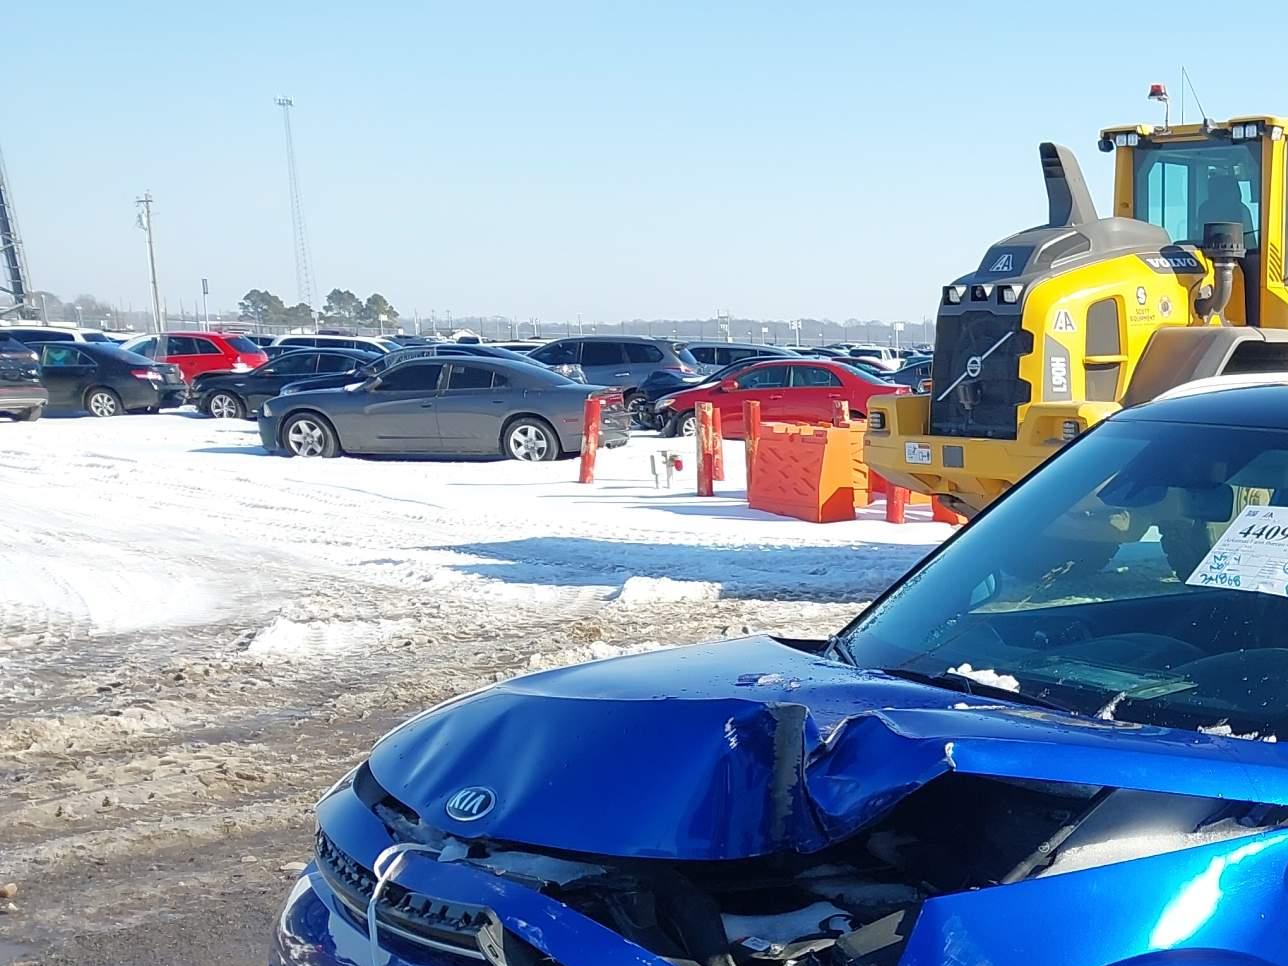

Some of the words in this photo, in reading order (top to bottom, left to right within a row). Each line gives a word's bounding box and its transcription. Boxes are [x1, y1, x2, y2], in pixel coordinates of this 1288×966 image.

[1146, 257, 1197, 268] VOLVO
[1051, 357, 1067, 392] L90H
[449, 789, 486, 815] KIA
